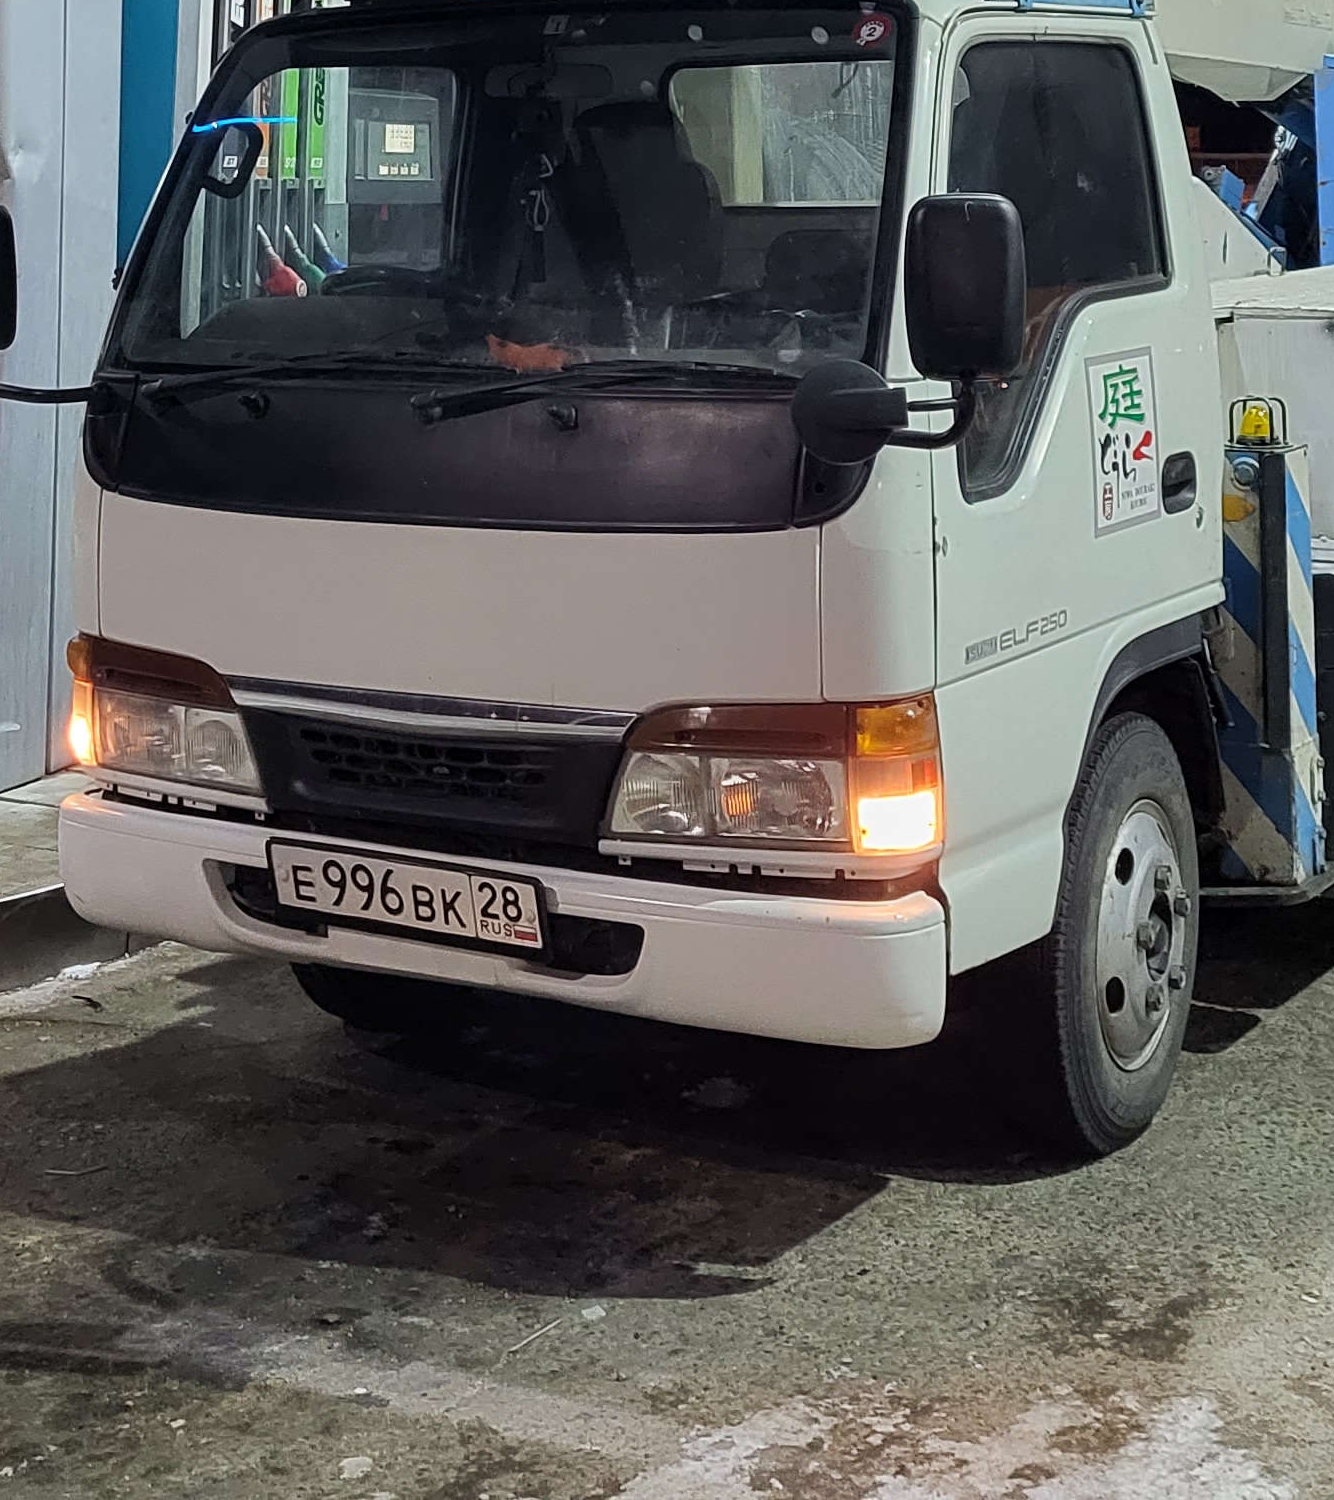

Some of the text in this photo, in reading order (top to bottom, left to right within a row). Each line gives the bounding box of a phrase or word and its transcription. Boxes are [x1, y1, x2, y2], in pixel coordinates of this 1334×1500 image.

[866, 26, 877, 38] 2
[1098, 364, 1145, 430] 庭
[292, 859, 522, 929] Е996ВК 28
[480, 921, 514, 938] RUS
